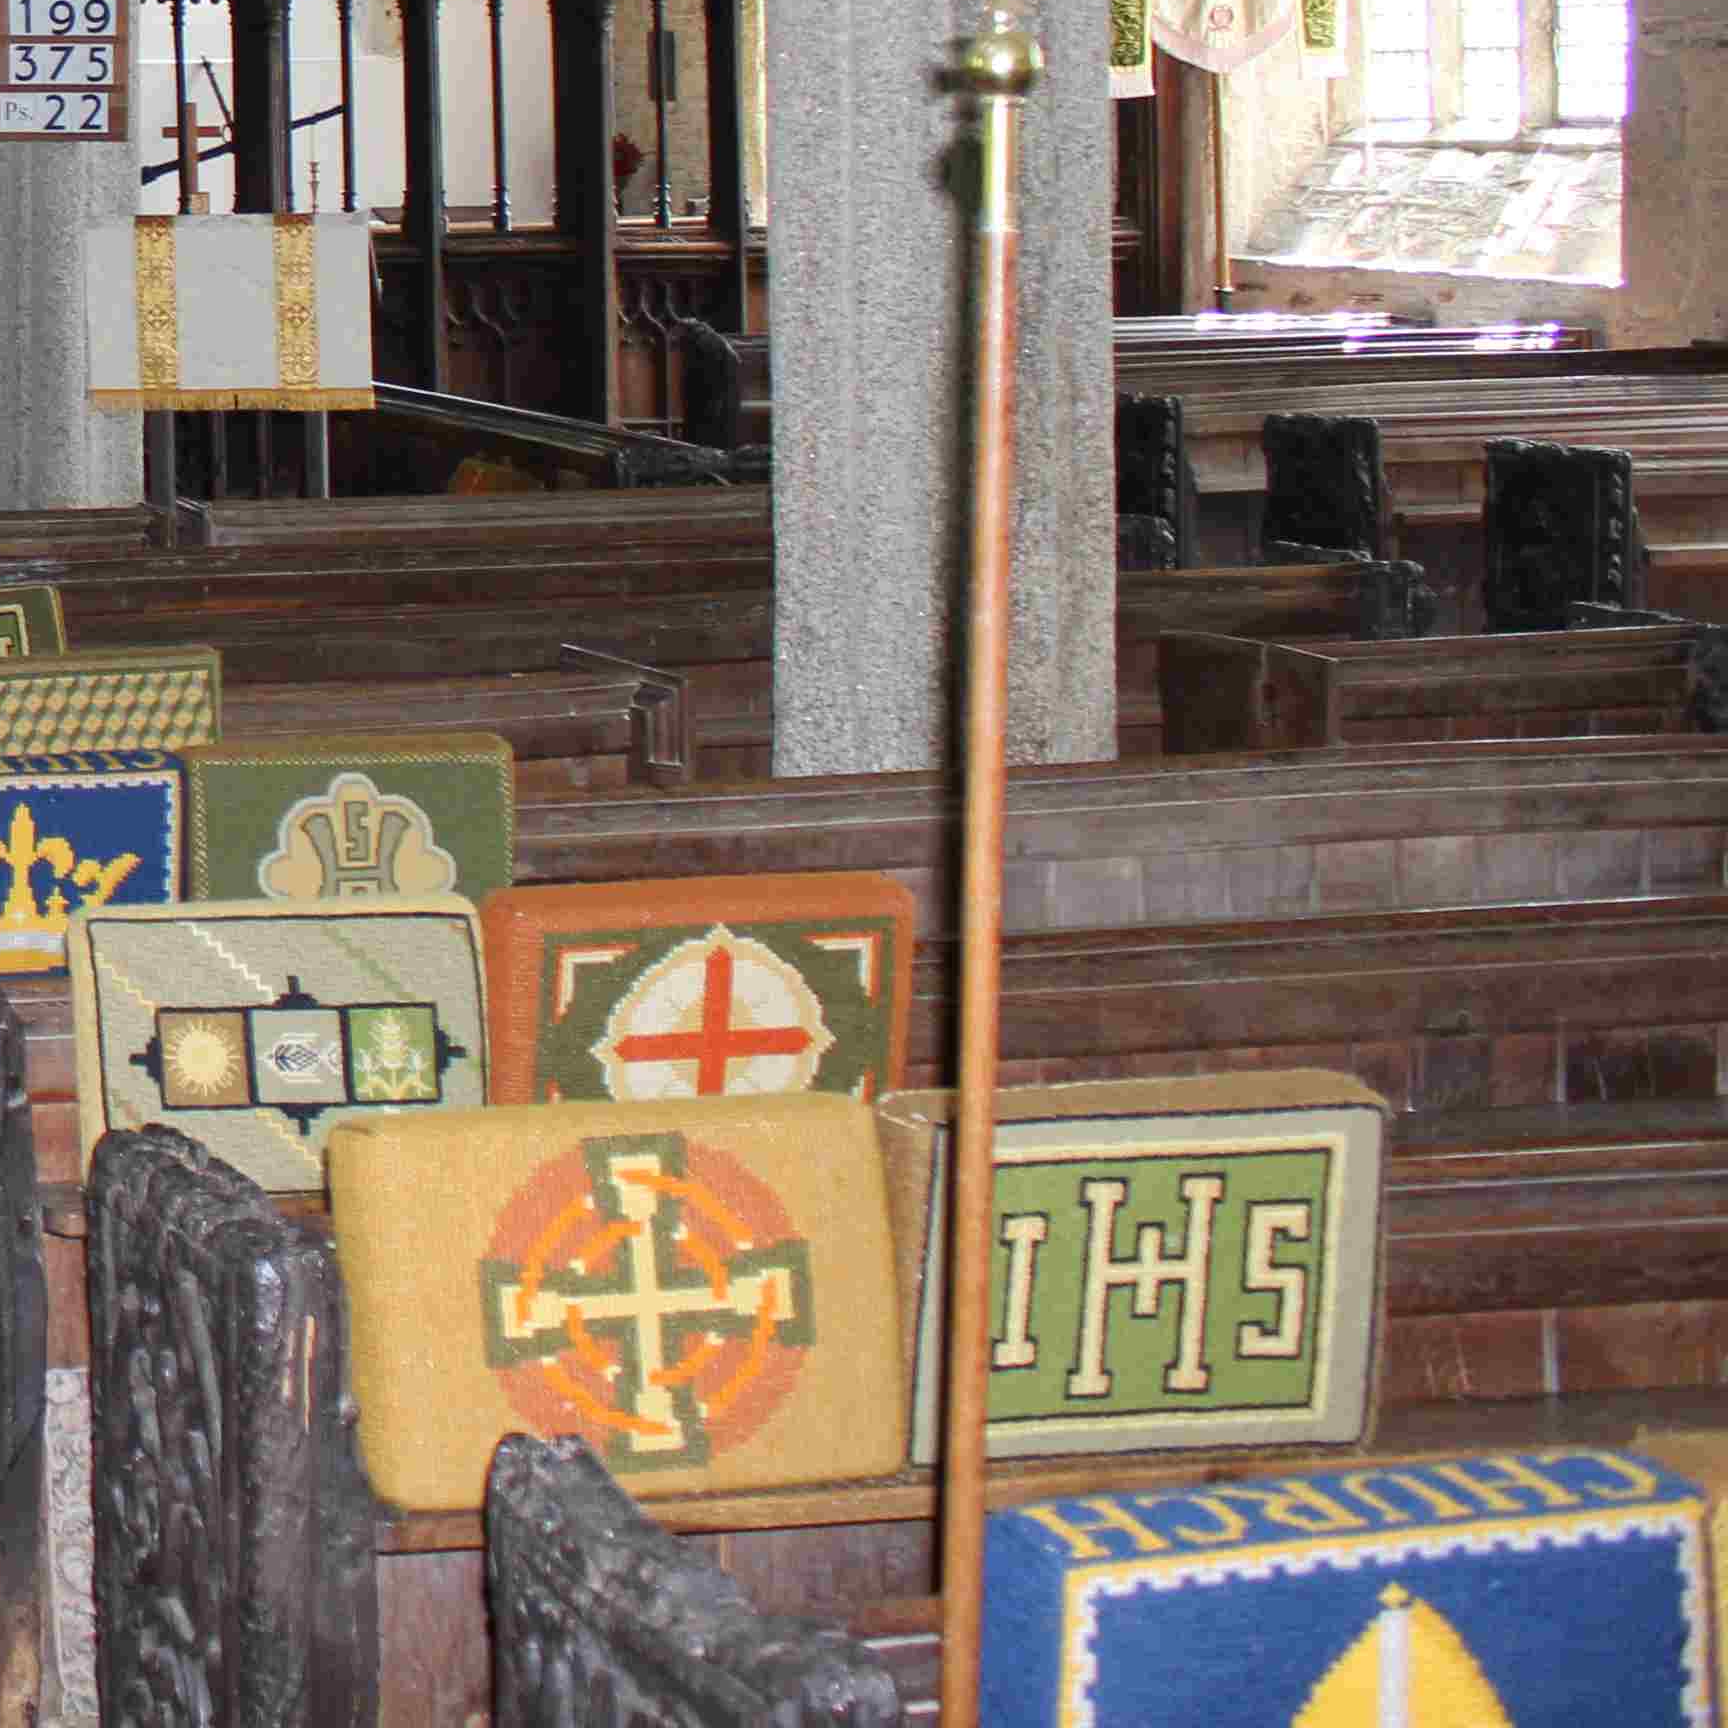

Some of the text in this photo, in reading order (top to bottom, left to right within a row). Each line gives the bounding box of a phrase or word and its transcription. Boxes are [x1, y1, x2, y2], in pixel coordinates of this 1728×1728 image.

[15, 45, 108, 83] 375
[44, 94, 102, 131] 22
[992, 1172, 1313, 1399] IHS
[1018, 1450, 1656, 1557] CHURCH
